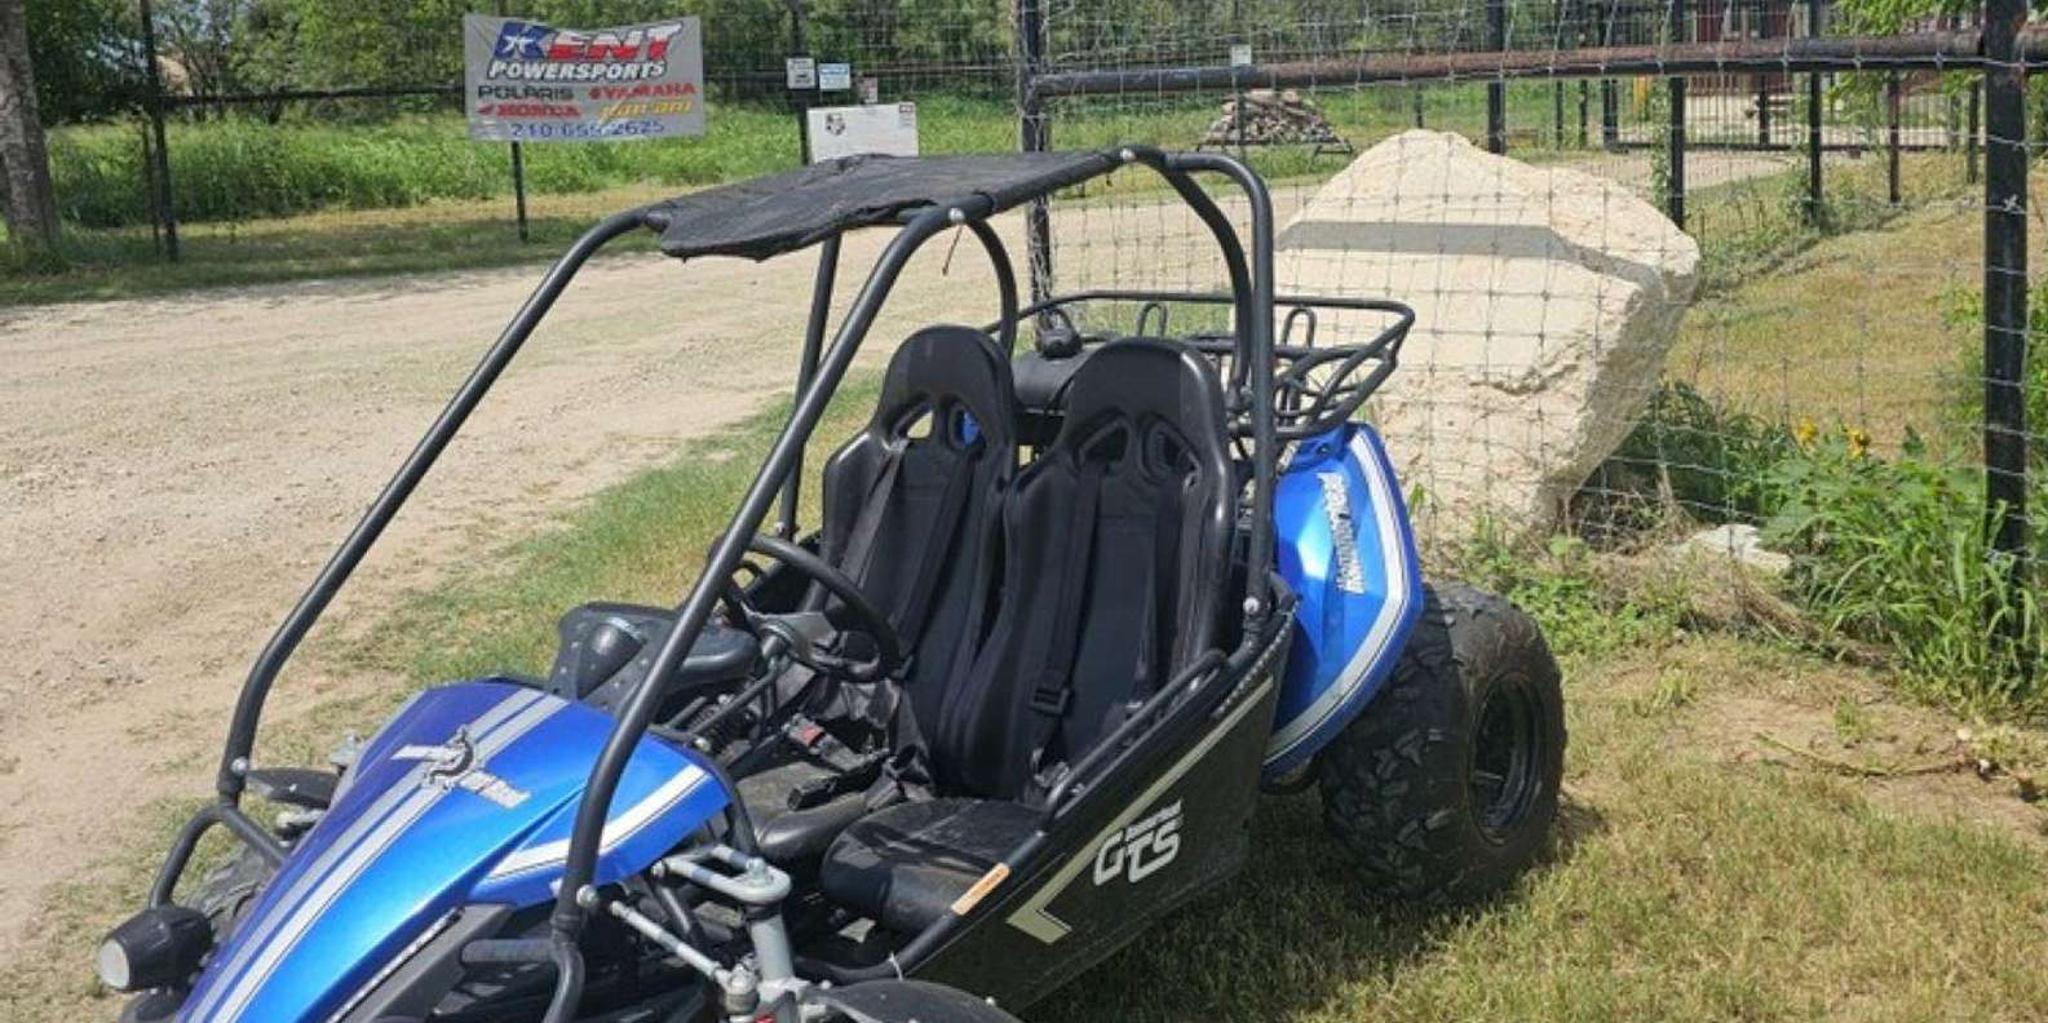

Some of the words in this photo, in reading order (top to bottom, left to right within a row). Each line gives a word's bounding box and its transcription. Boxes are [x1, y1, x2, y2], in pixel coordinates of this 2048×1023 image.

[493, 21, 684, 62] KENT
[488, 60, 668, 82] POWERSPORTS
[478, 84, 574, 100] POLARIS
[602, 82, 696, 99] YAMAHA
[1093, 814, 1184, 885] GTS
